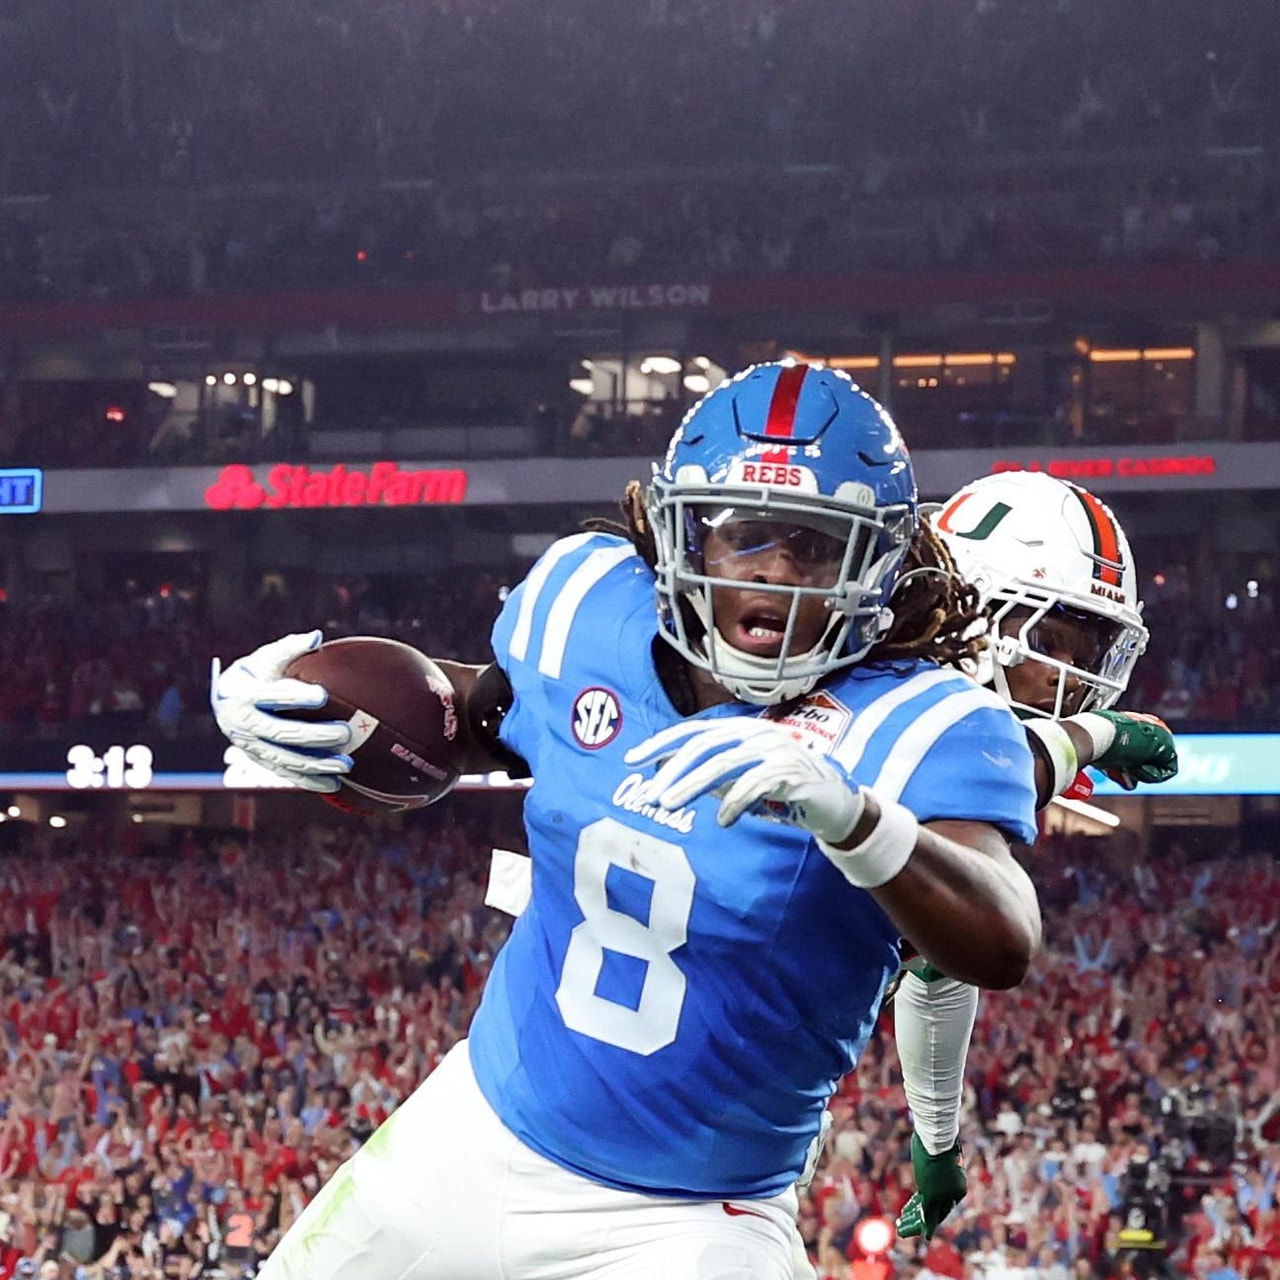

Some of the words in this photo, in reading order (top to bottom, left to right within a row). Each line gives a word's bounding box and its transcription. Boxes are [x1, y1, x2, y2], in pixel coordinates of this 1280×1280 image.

[590, 284, 712, 309] WILSON
[742, 464, 802, 487] REBS
[1090, 583, 1127, 605] MIAMI
[573, 689, 619, 745] SEC
[66, 744, 153, 789] 3:13
[553, 815, 697, 1057] 8
